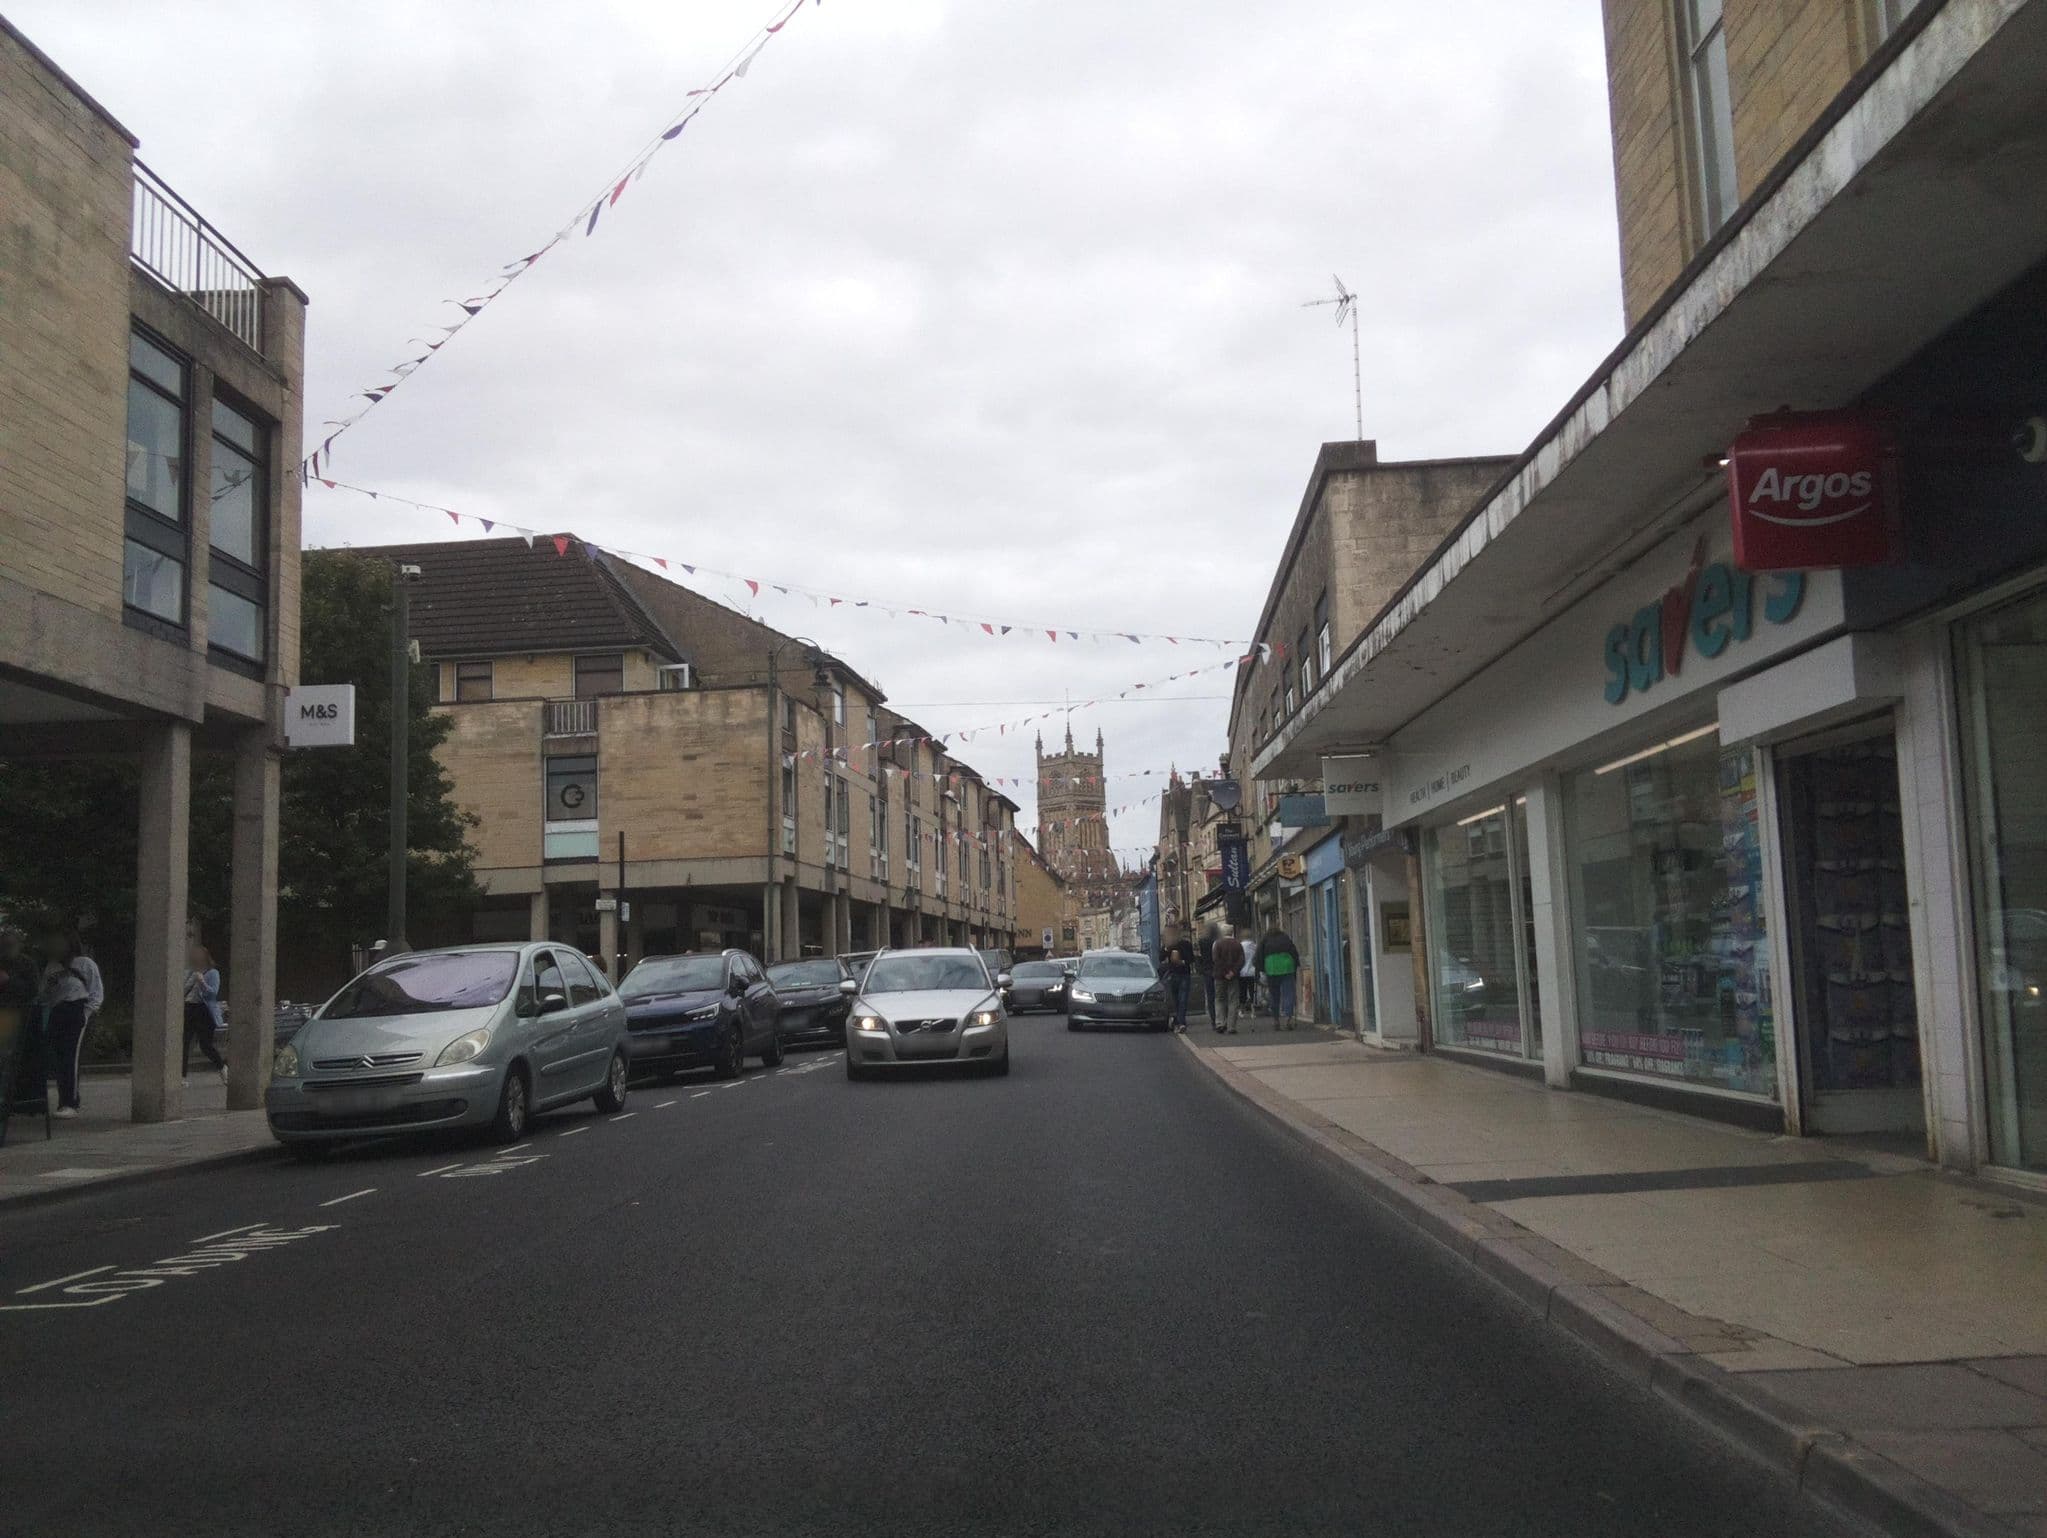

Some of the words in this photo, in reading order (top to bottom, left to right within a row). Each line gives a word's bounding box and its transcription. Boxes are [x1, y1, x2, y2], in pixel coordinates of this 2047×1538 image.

[1749, 467, 1872, 509] Argos
[1604, 534, 1807, 705] savers
[301, 704, 338, 719] M&S
[1328, 781, 1379, 794] savers
[1451, 764, 1472, 785] BEAUTY
[1227, 847, 1240, 888] Sultan
[0, 1224, 342, 1311] LOADING
